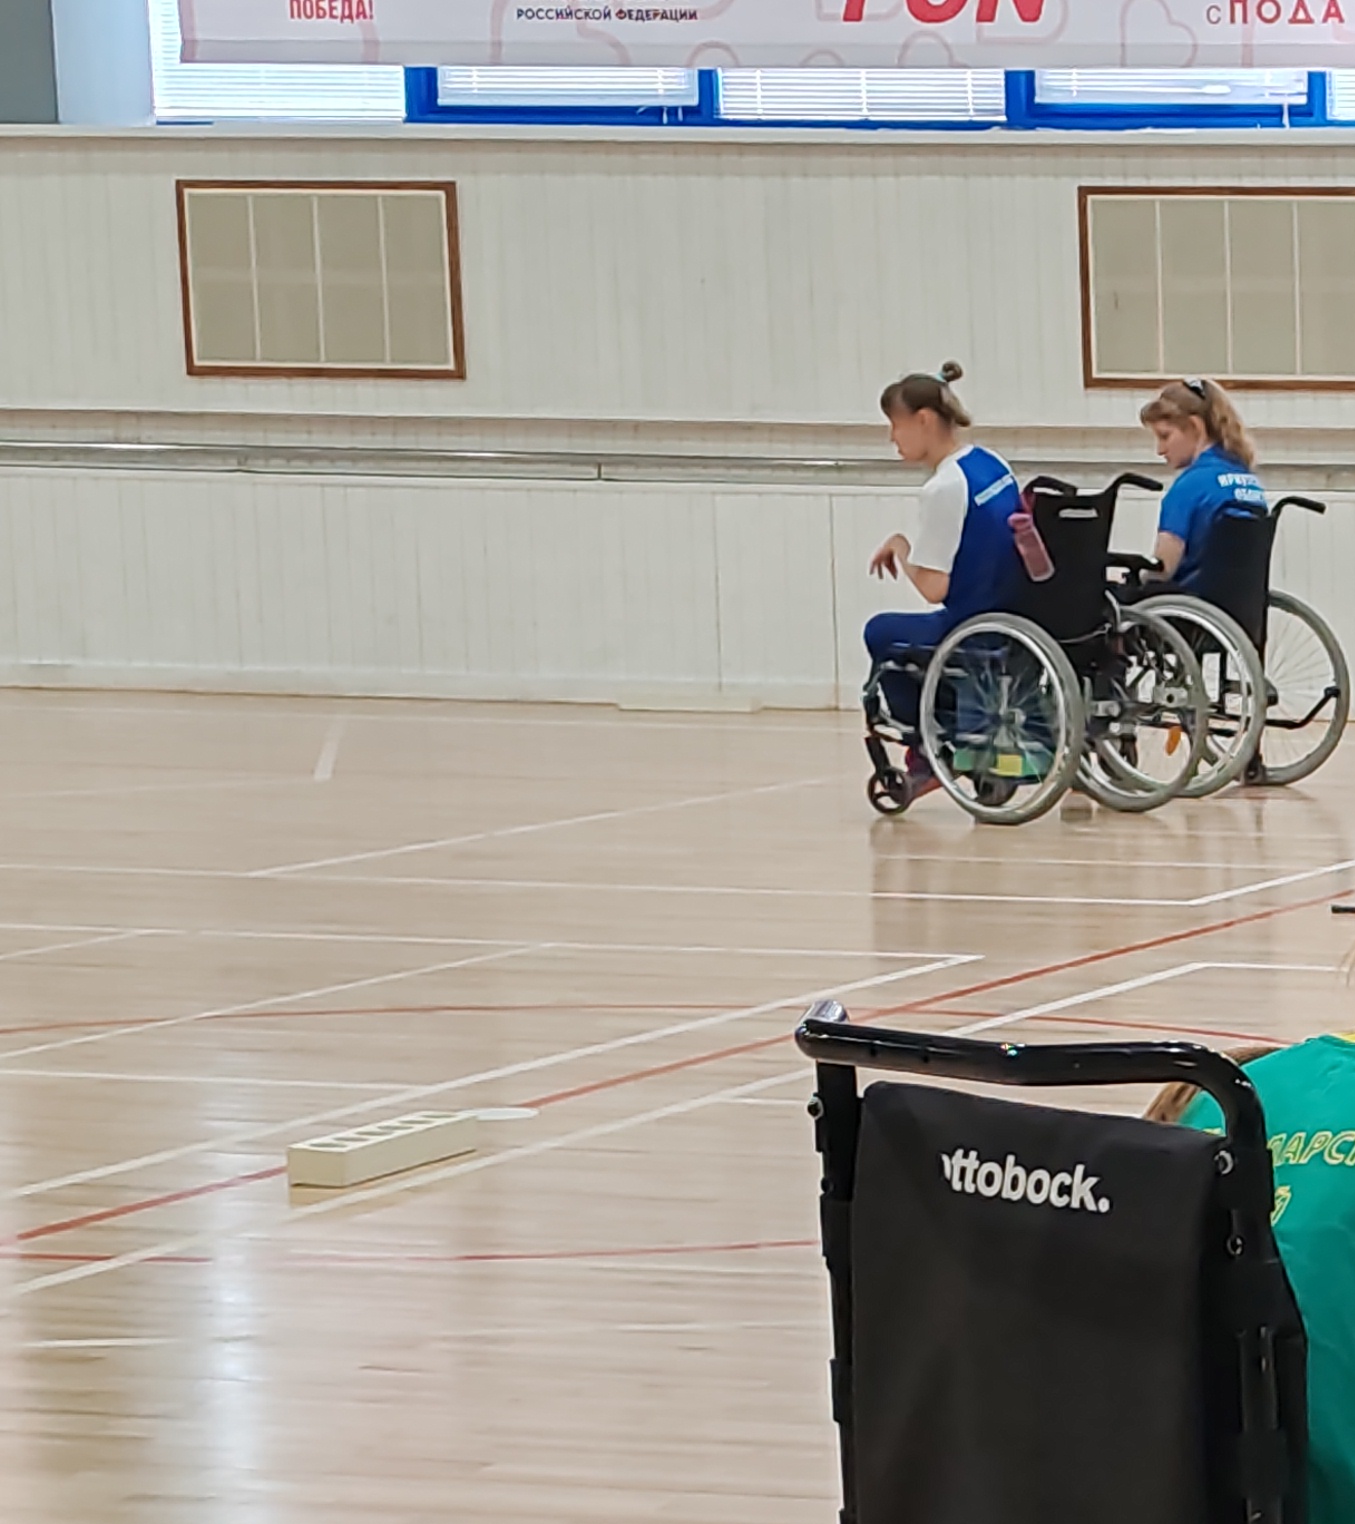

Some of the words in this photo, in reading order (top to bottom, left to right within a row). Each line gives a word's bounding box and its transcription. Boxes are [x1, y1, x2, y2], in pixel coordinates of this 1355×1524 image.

[289, 0, 374, 24] ПОБЕДА!
[515, 5, 612, 21] РОССИЙСКОЙ
[615, 8, 698, 22] ФЕДЕРАЦИИ
[1229, 0, 1345, 25] ПОДА
